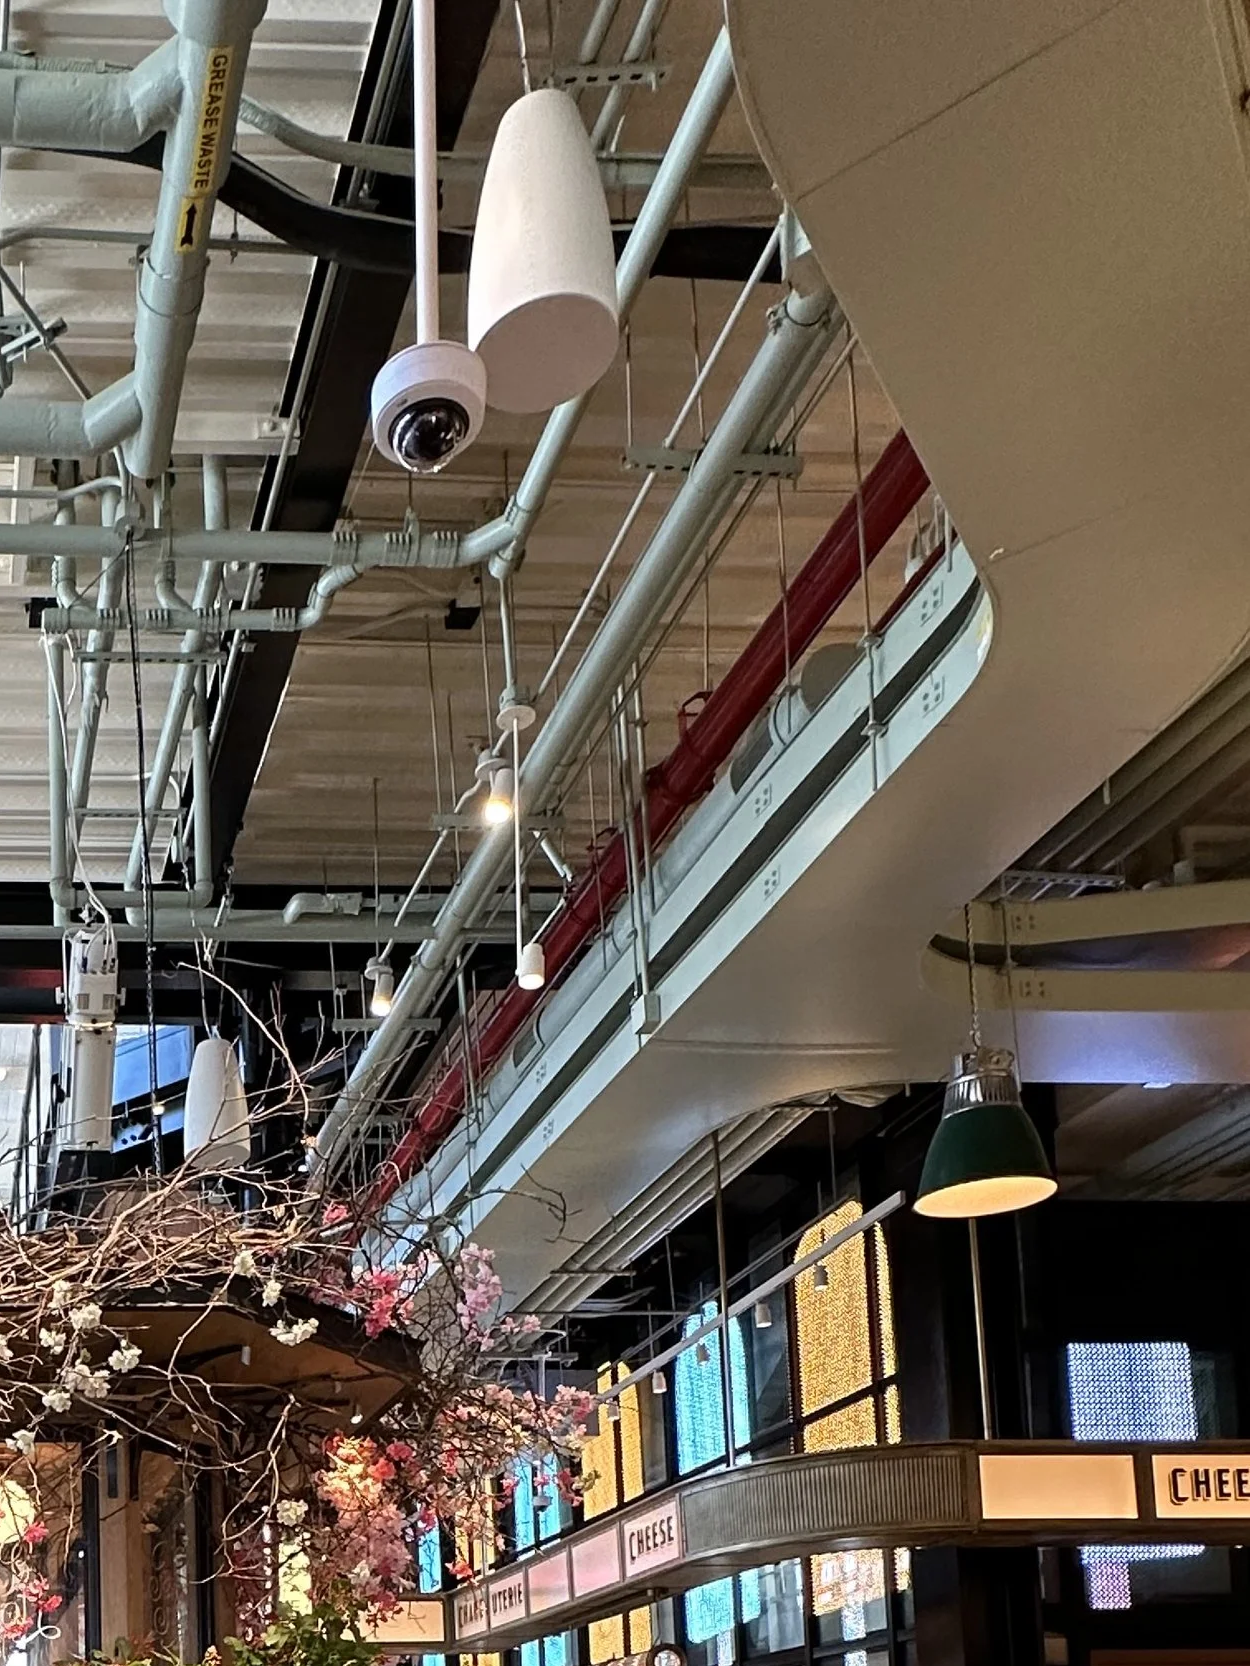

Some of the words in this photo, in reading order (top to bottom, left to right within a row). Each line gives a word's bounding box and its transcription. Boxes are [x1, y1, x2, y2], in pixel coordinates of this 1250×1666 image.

[204, 54, 228, 129] GREASE
[194, 133, 216, 189] WASTE
[1168, 1467, 1250, 1506] CHEE
[629, 1515, 674, 1563] CHEESE
